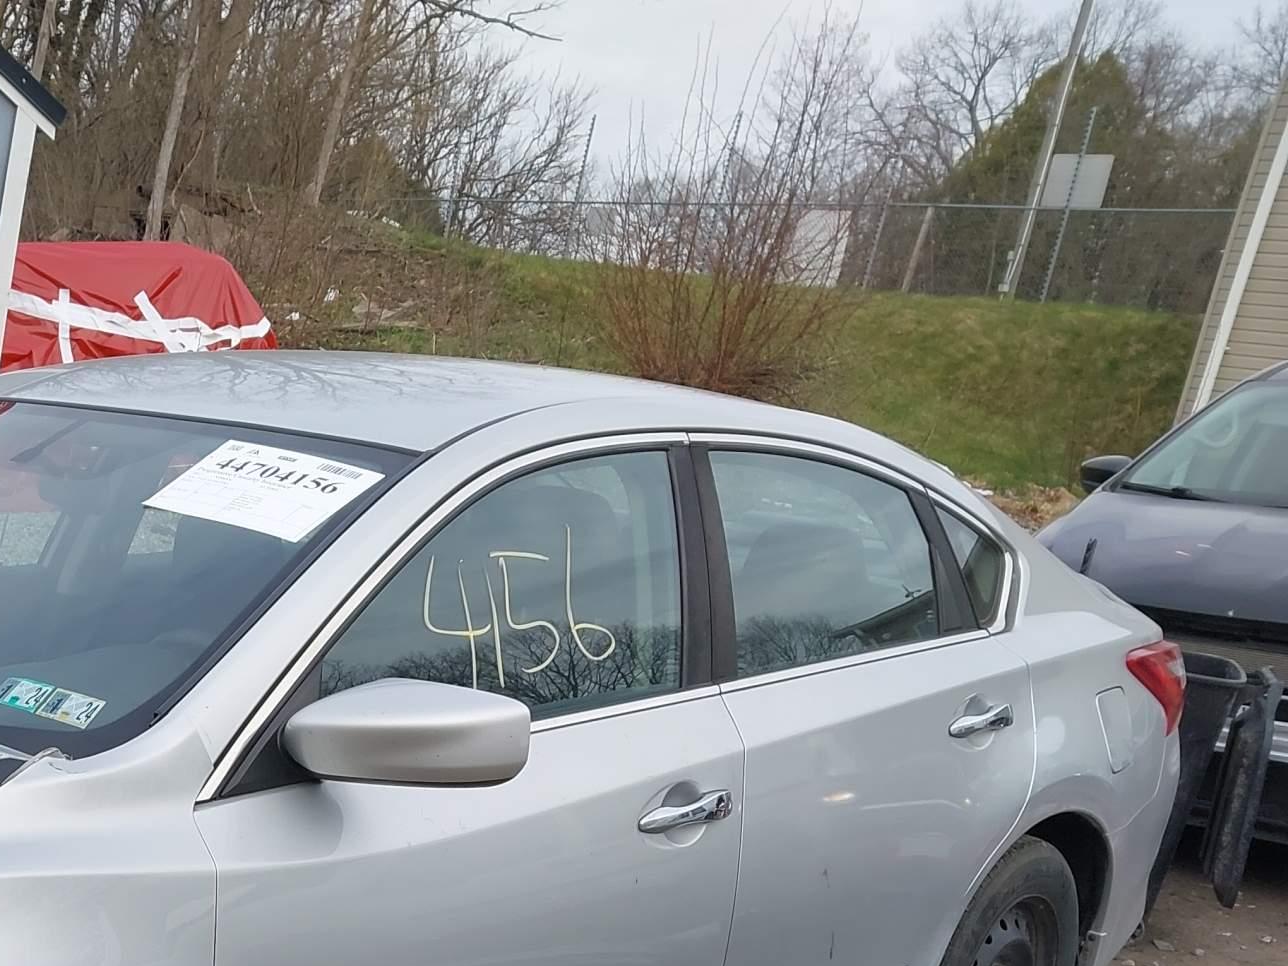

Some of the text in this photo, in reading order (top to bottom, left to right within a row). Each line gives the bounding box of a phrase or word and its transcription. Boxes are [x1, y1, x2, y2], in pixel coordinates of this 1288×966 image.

[215, 457, 344, 495] 44704156
[24, 686, 50, 707] 24
[76, 701, 101, 724] 24
